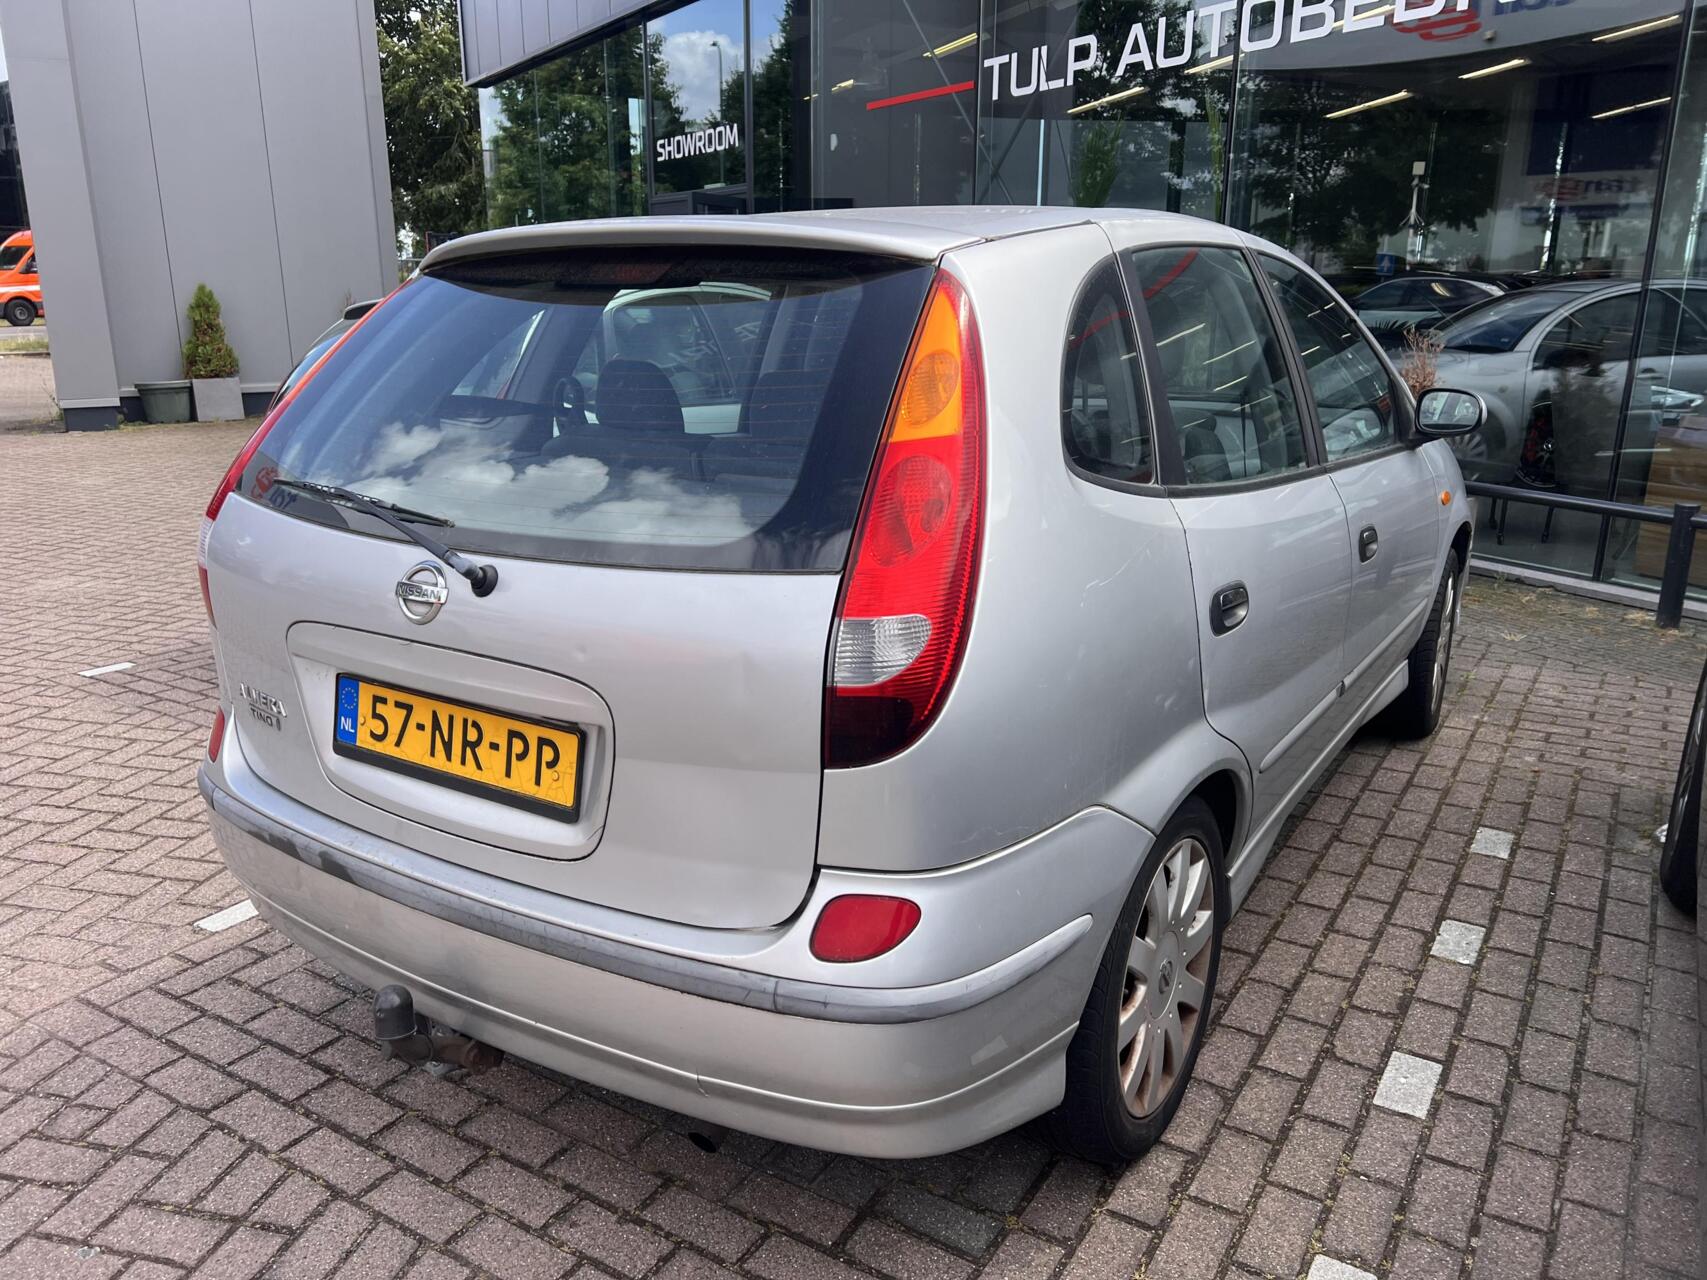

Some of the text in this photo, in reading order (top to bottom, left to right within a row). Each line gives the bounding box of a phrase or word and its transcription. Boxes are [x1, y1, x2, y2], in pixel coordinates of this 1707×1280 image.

[983, 0, 1472, 101] TULP AUTOBE
[656, 122, 739, 162] SHOWROOM
[399, 583, 442, 602] NISSAN
[340, 715, 355, 733] NL
[369, 694, 561, 787] 57-NR-PP
